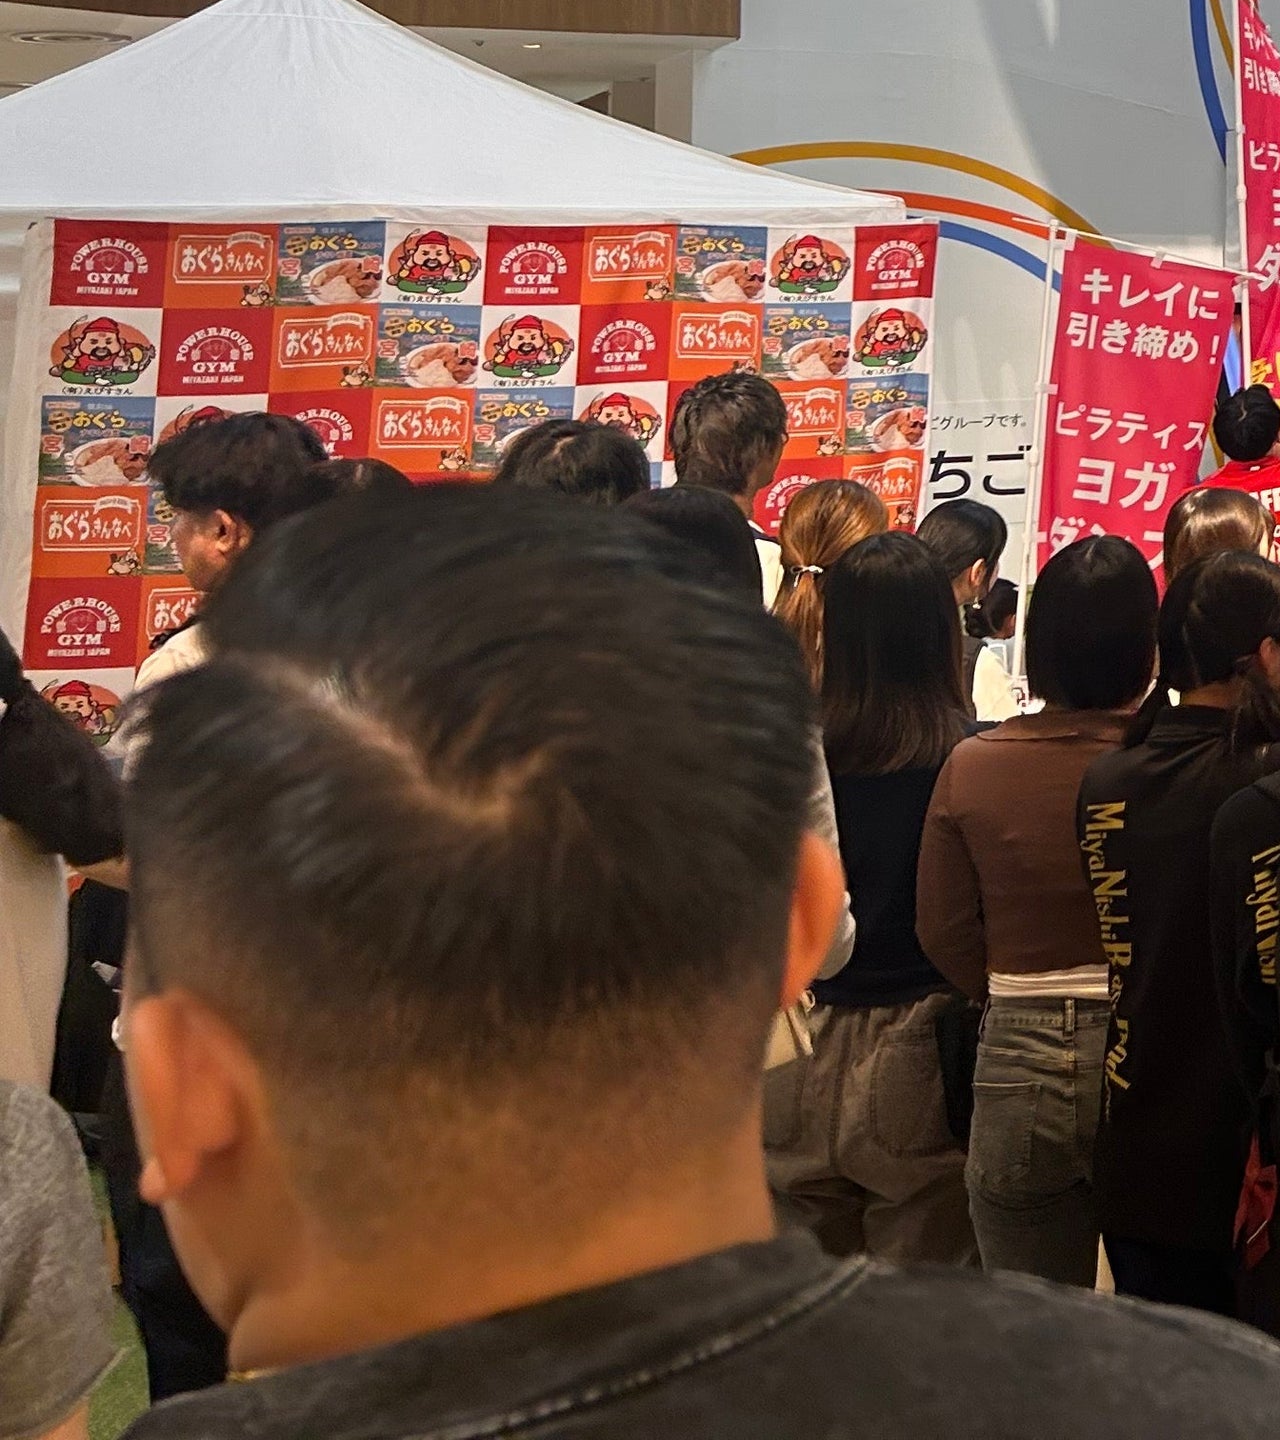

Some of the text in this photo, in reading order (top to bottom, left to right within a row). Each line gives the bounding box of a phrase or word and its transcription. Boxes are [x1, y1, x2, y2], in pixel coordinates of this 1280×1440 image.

[70, 237, 148, 274] POWERHOUSE
[500, 242, 567, 274] POWERHOUSE
[866, 240, 925, 272] POWERHOUSE
[87, 273, 129, 284] GYM
[514, 274, 552, 285] GYM
[879, 269, 912, 281] GYM
[1080, 267, 1220, 320] キレイに
[176, 326, 253, 363] POWERHOUSE
[591, 320, 656, 354] POWERHOUSE
[1066, 311, 1222, 365] 引き締め！
[193, 362, 235, 373] GYM
[603, 352, 640, 363] GYM
[296, 408, 353, 441] ERHOUSE
[1056, 401, 1206, 452] ピラティス
[929, 445, 1032, 500] ちご
[1073, 457, 1177, 512] ヨガ
[41, 597, 121, 634] POWERHOUSE
[58, 633, 102, 646] GYM
